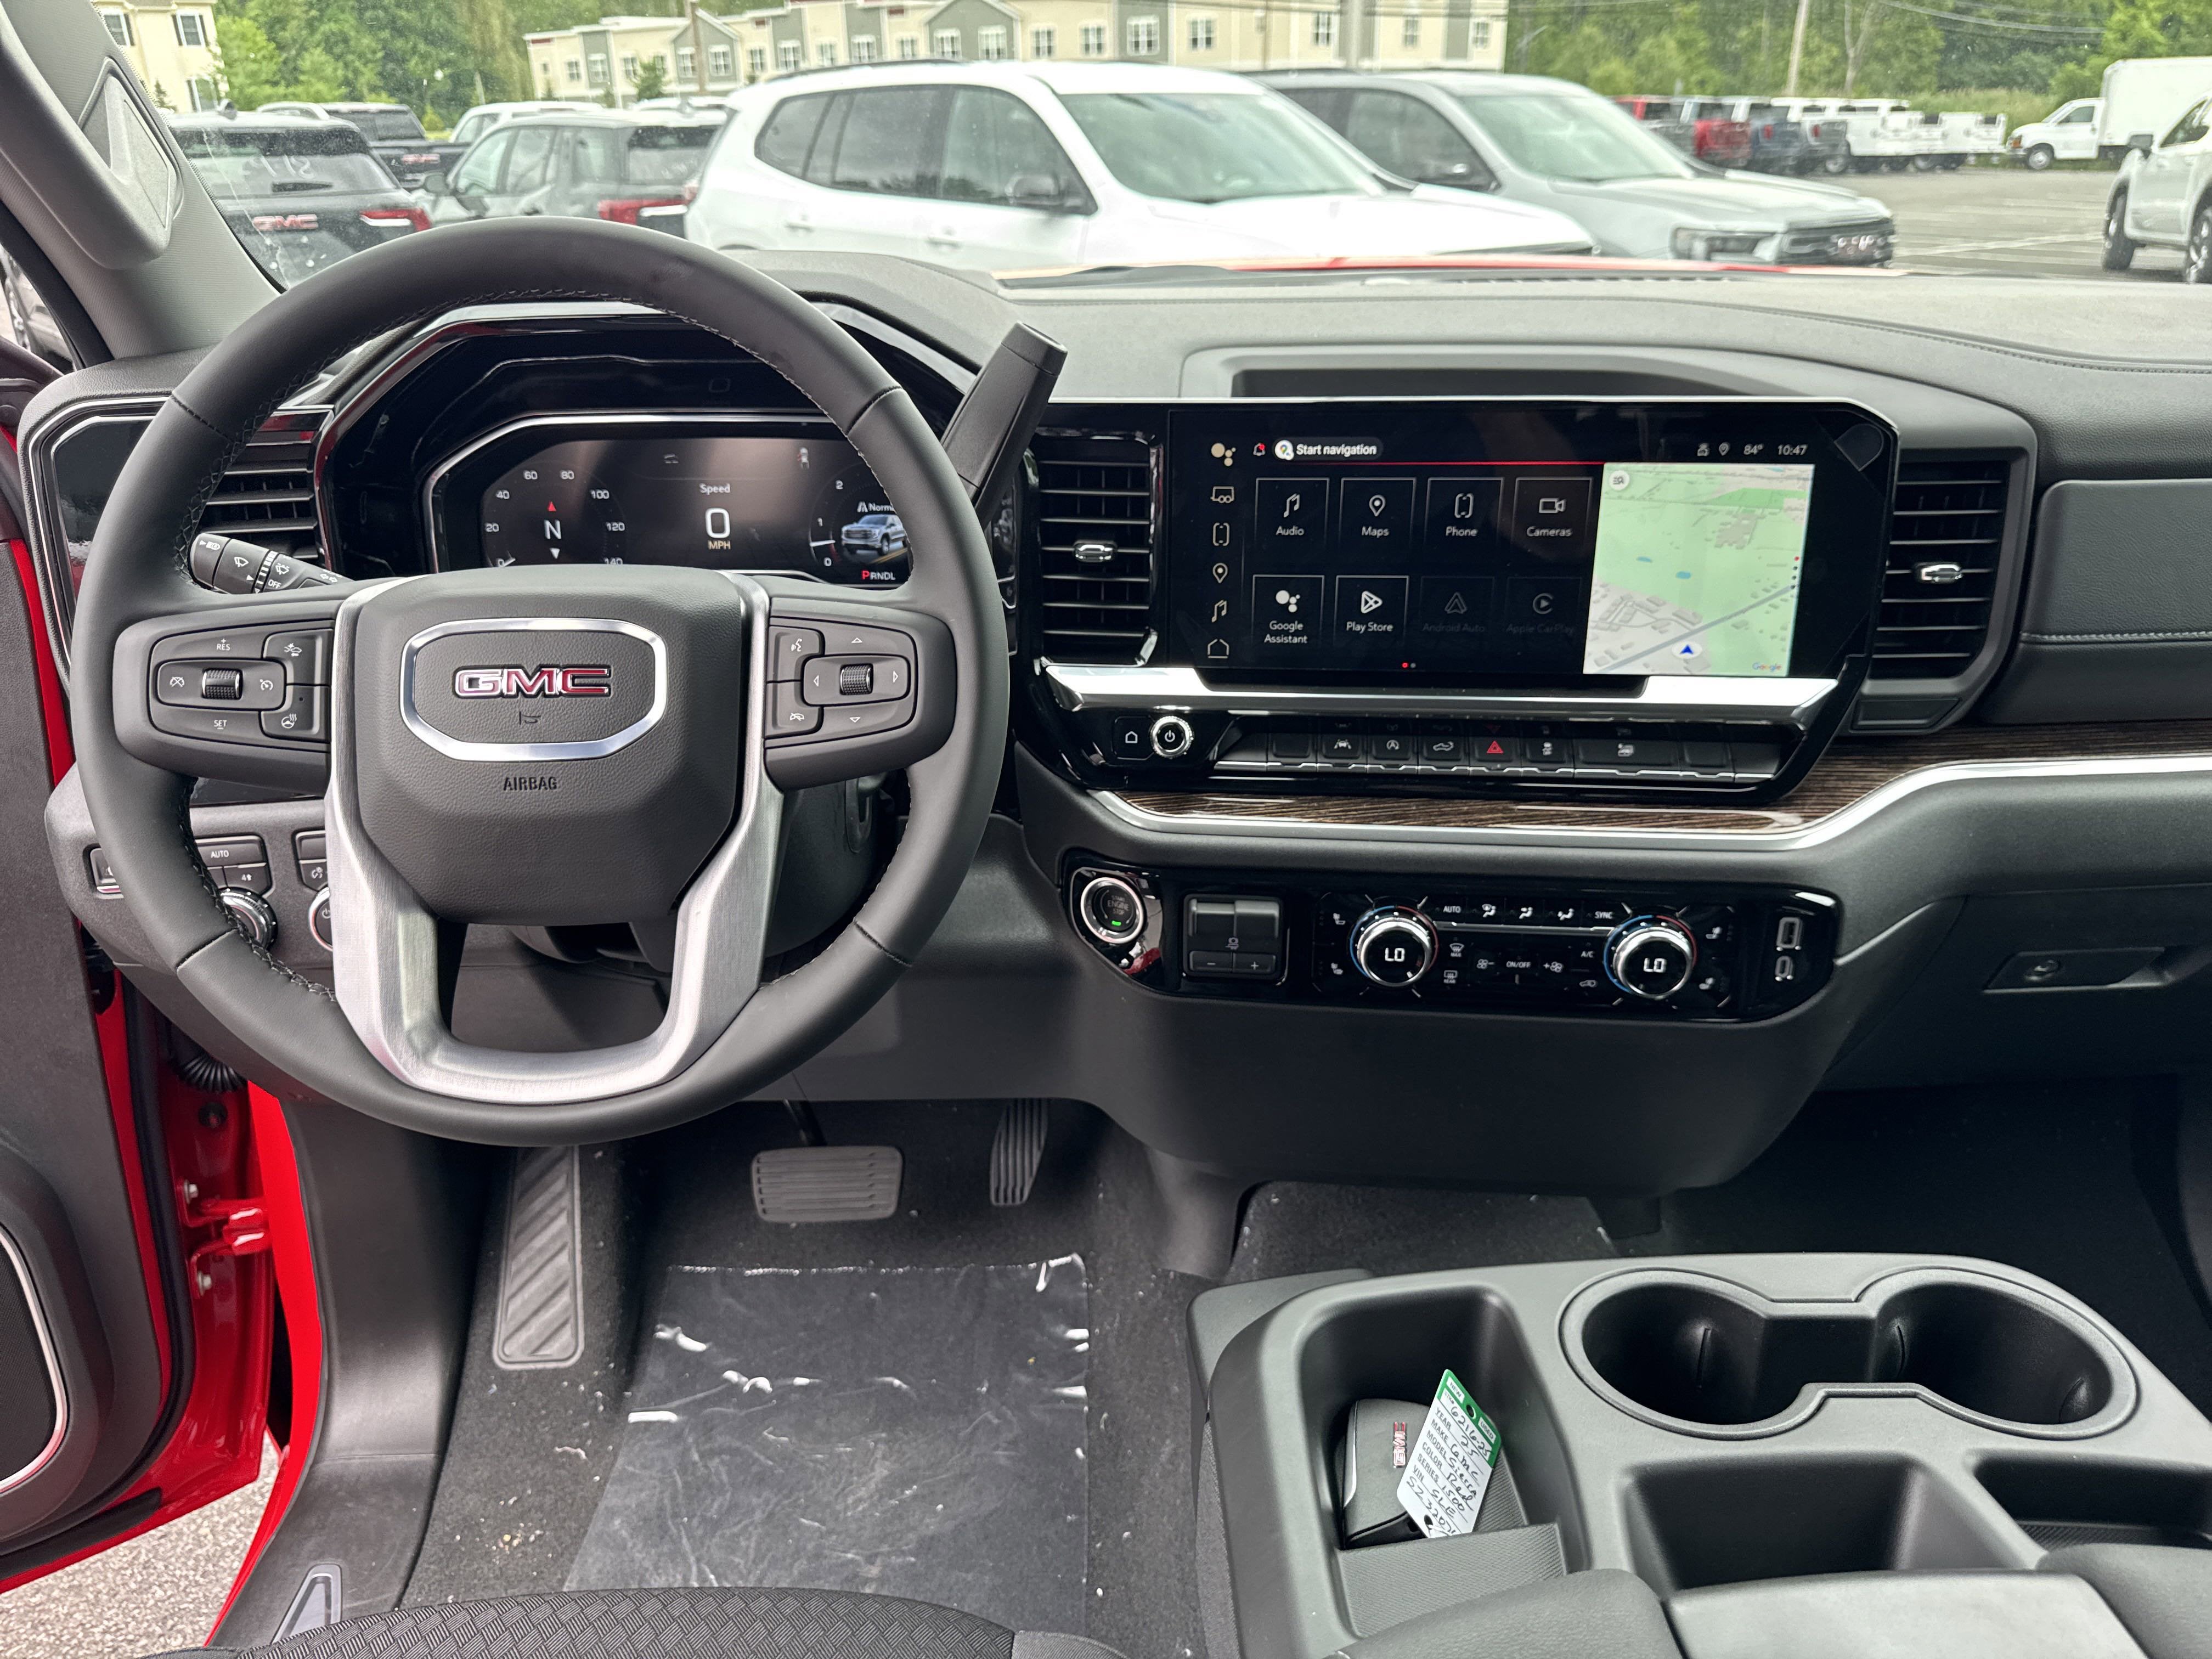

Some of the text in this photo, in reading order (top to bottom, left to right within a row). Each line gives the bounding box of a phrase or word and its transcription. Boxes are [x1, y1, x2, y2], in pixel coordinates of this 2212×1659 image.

[253, 214, 319, 232] GMC
[1296, 444, 1377, 457] Start navigation
[1778, 444, 1808, 455] 10:47
[523, 470, 538, 480] 60
[560, 470, 574, 480] 80
[699, 483, 731, 494] Speed
[836, 480, 843, 490] 2
[496, 490, 510, 499] 40
[591, 490, 610, 499] 100
[868, 503, 894, 512] Norm
[485, 523, 500, 532] 20
[607, 522, 625, 532] 120
[706, 508, 730, 539] 0
[818, 518, 823, 527] 1
[545, 520, 561, 539] N
[1276, 526, 1304, 537] Audio
[1362, 526, 1389, 538] Maps
[1446, 526, 1477, 537] Phone
[1526, 526, 1572, 537] Cameras
[708, 541, 731, 550] MPH
[823, 557, 832, 566] 0
[861, 570, 896, 580] PRNDL
[268, 580, 281, 589] OFF
[1269, 620, 1304, 634] Google
[1346, 622, 1393, 634] Play Store
[1264, 634, 1307, 644] Assistant
[1752, 662, 1781, 672] Google
[456, 668, 611, 697] GMC
[503, 777, 557, 792] AIRBAG
[211, 850, 229, 859] AUTO
[1107, 900, 1129, 911] ENGINE
[1594, 911, 1613, 919] SYNC
[1449, 1381, 1462, 1397] NEW
[1436, 1407, 1451, 1430] YEAR
[1431, 1418, 1448, 1442] MAKE
[1480, 1421, 1493, 1440] USED
[1426, 1430, 1447, 1459] MODEL
[1460, 1435, 1480, 1457] 25
[1422, 1441, 1442, 1470] COLOR
[1413, 1464, 1424, 1482] VIN
[1417, 1453, 1439, 1482] SERIES
[1446, 1472, 1474, 1511] Red
